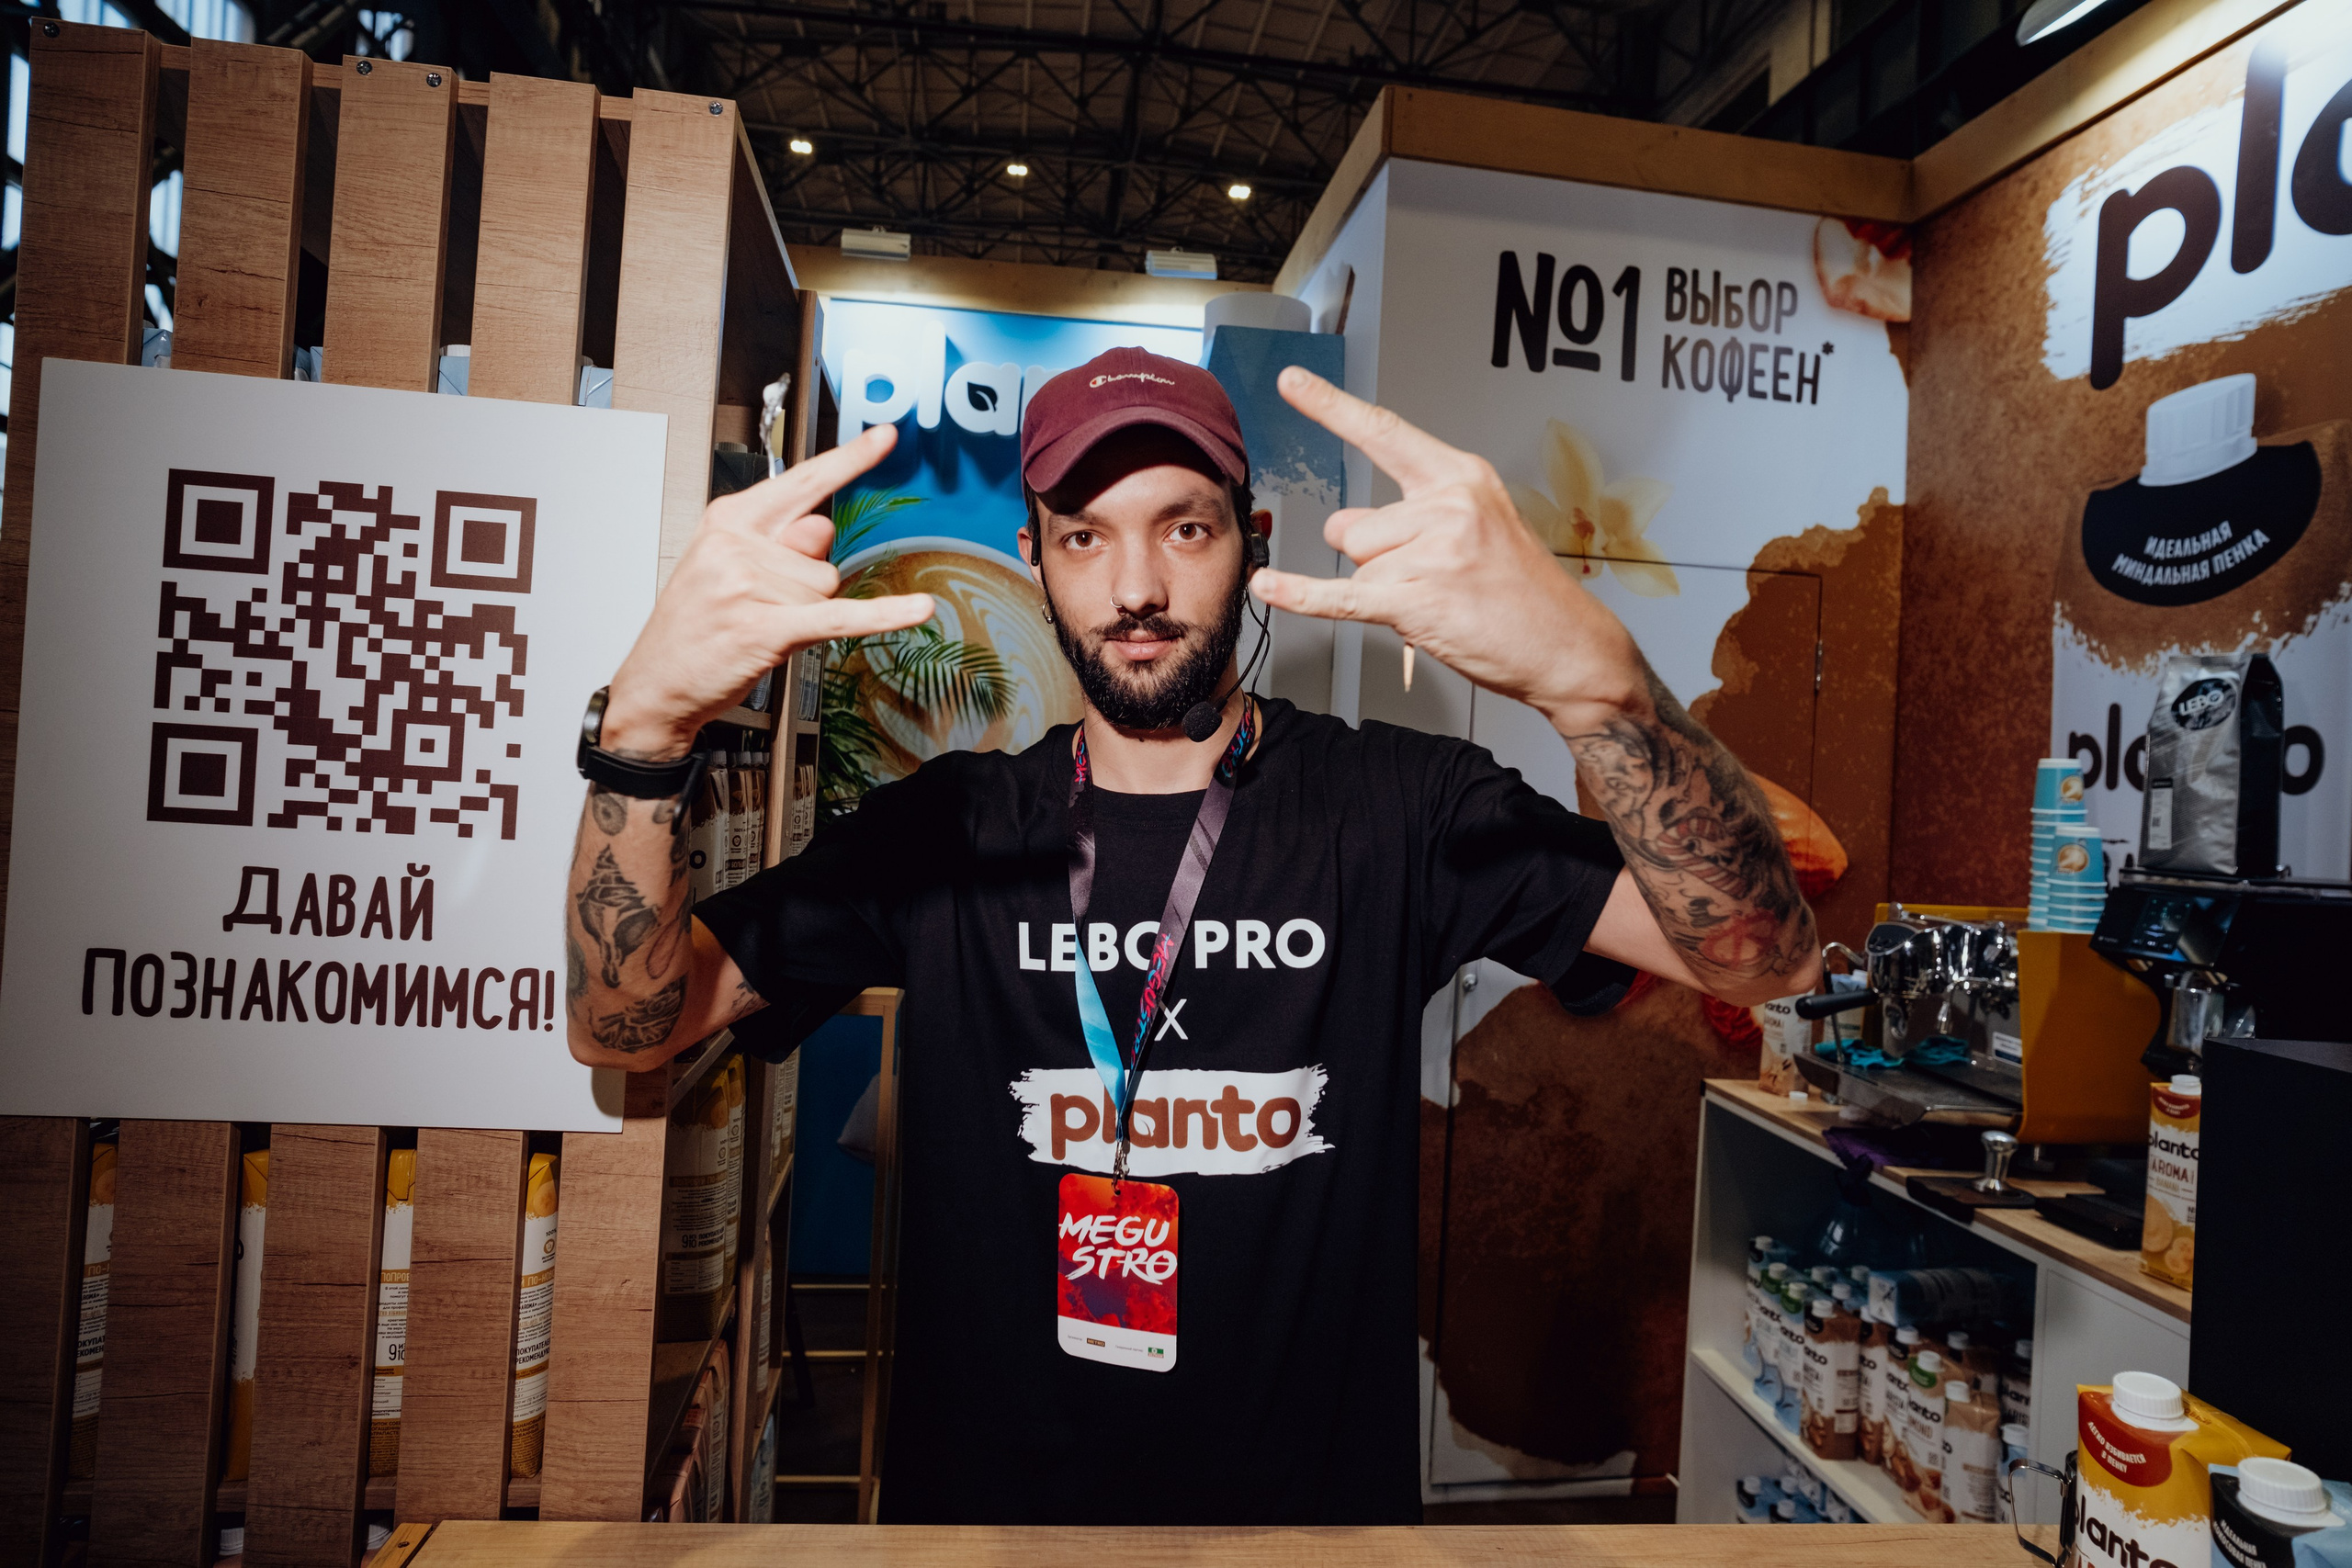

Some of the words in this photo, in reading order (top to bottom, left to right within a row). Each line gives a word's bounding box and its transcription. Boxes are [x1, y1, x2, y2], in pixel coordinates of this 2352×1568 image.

[1665, 266, 1798, 334] ВЫБОР
[1090, 372, 1175, 388] Champion
[2110, 552, 2211, 587] МИНДАЛЬНАЯ
[2212, 527, 2271, 574] ПЕНКА
[2143, 520, 2233, 560] ИДЕАЛЬНАЯ
[2177, 689, 2224, 716] LEBO
[222, 863, 435, 942] ДАВАЙ
[1193, 918, 1326, 970] PRO
[81, 947, 556, 1033] ПОЗНАКОМИМСЯ!
[2152, 1158, 2188, 1183] AROMA
[682, 1235, 689, 1248] 9
[1058, 1212, 1170, 1247] MEGU
[1065, 1246, 1178, 1286] STRO
[389, 1344, 397, 1361] 9
[2087, 1421, 2106, 1445] ЛЕГКО
[2104, 1440, 2147, 1465] ВЗБИВАЕТСЯ
[2100, 1450, 2109, 1460] В
[2107, 1454, 2128, 1473] ПЕНКУ
[2075, 1495, 2180, 1568] lant
[2220, 1518, 2258, 1557] ИДЕАЛЬНАЯ
